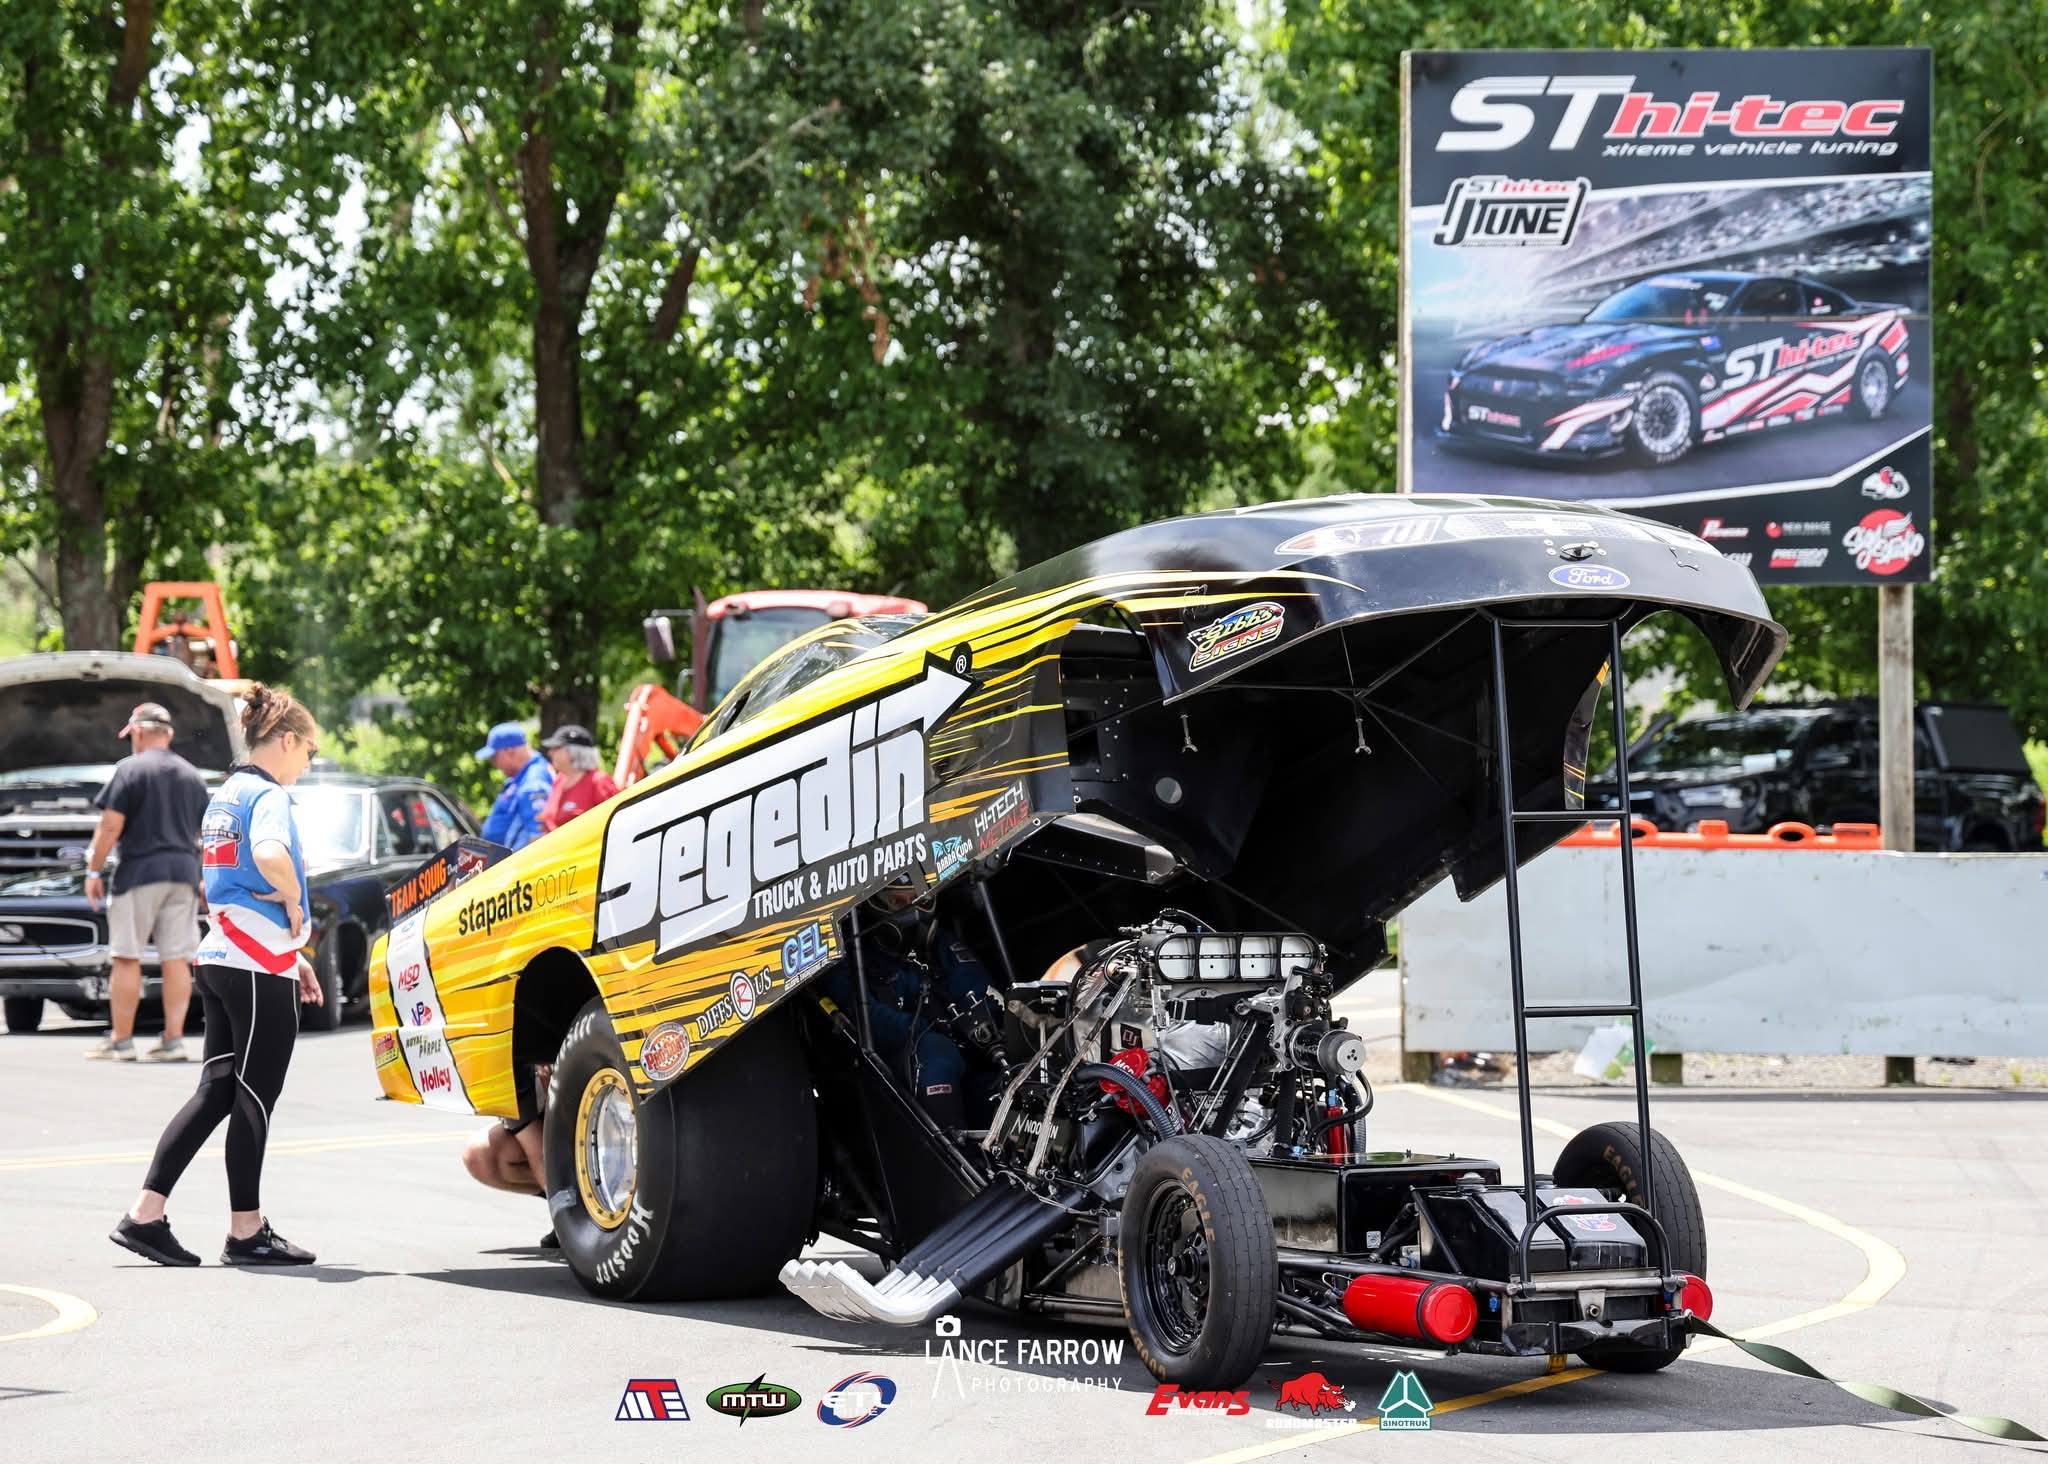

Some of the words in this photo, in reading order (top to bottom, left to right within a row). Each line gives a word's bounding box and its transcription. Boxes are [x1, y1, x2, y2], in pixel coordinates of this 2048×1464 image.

[1602, 143, 1693, 157] xtreme
[1705, 142, 1800, 156] vehicle
[1810, 140, 1898, 157] tuning
[1567, 567, 1615, 587] Ford
[597, 690, 932, 954] Segedin
[975, 780, 1024, 837] HI-TECH
[979, 799, 1030, 850] METALS
[391, 877, 418, 919] TEAM
[419, 857, 446, 900] SQUIG
[754, 881, 804, 919] TRUCK
[809, 876, 822, 900] &
[826, 853, 868, 896] AUTO
[873, 833, 926, 878] PARTS
[398, 963, 420, 989] MSD
[782, 921, 829, 978] GEL
[696, 995, 734, 1039] DIFFS
[754, 967, 772, 997] US
[419, 1066, 452, 1093] Holley
